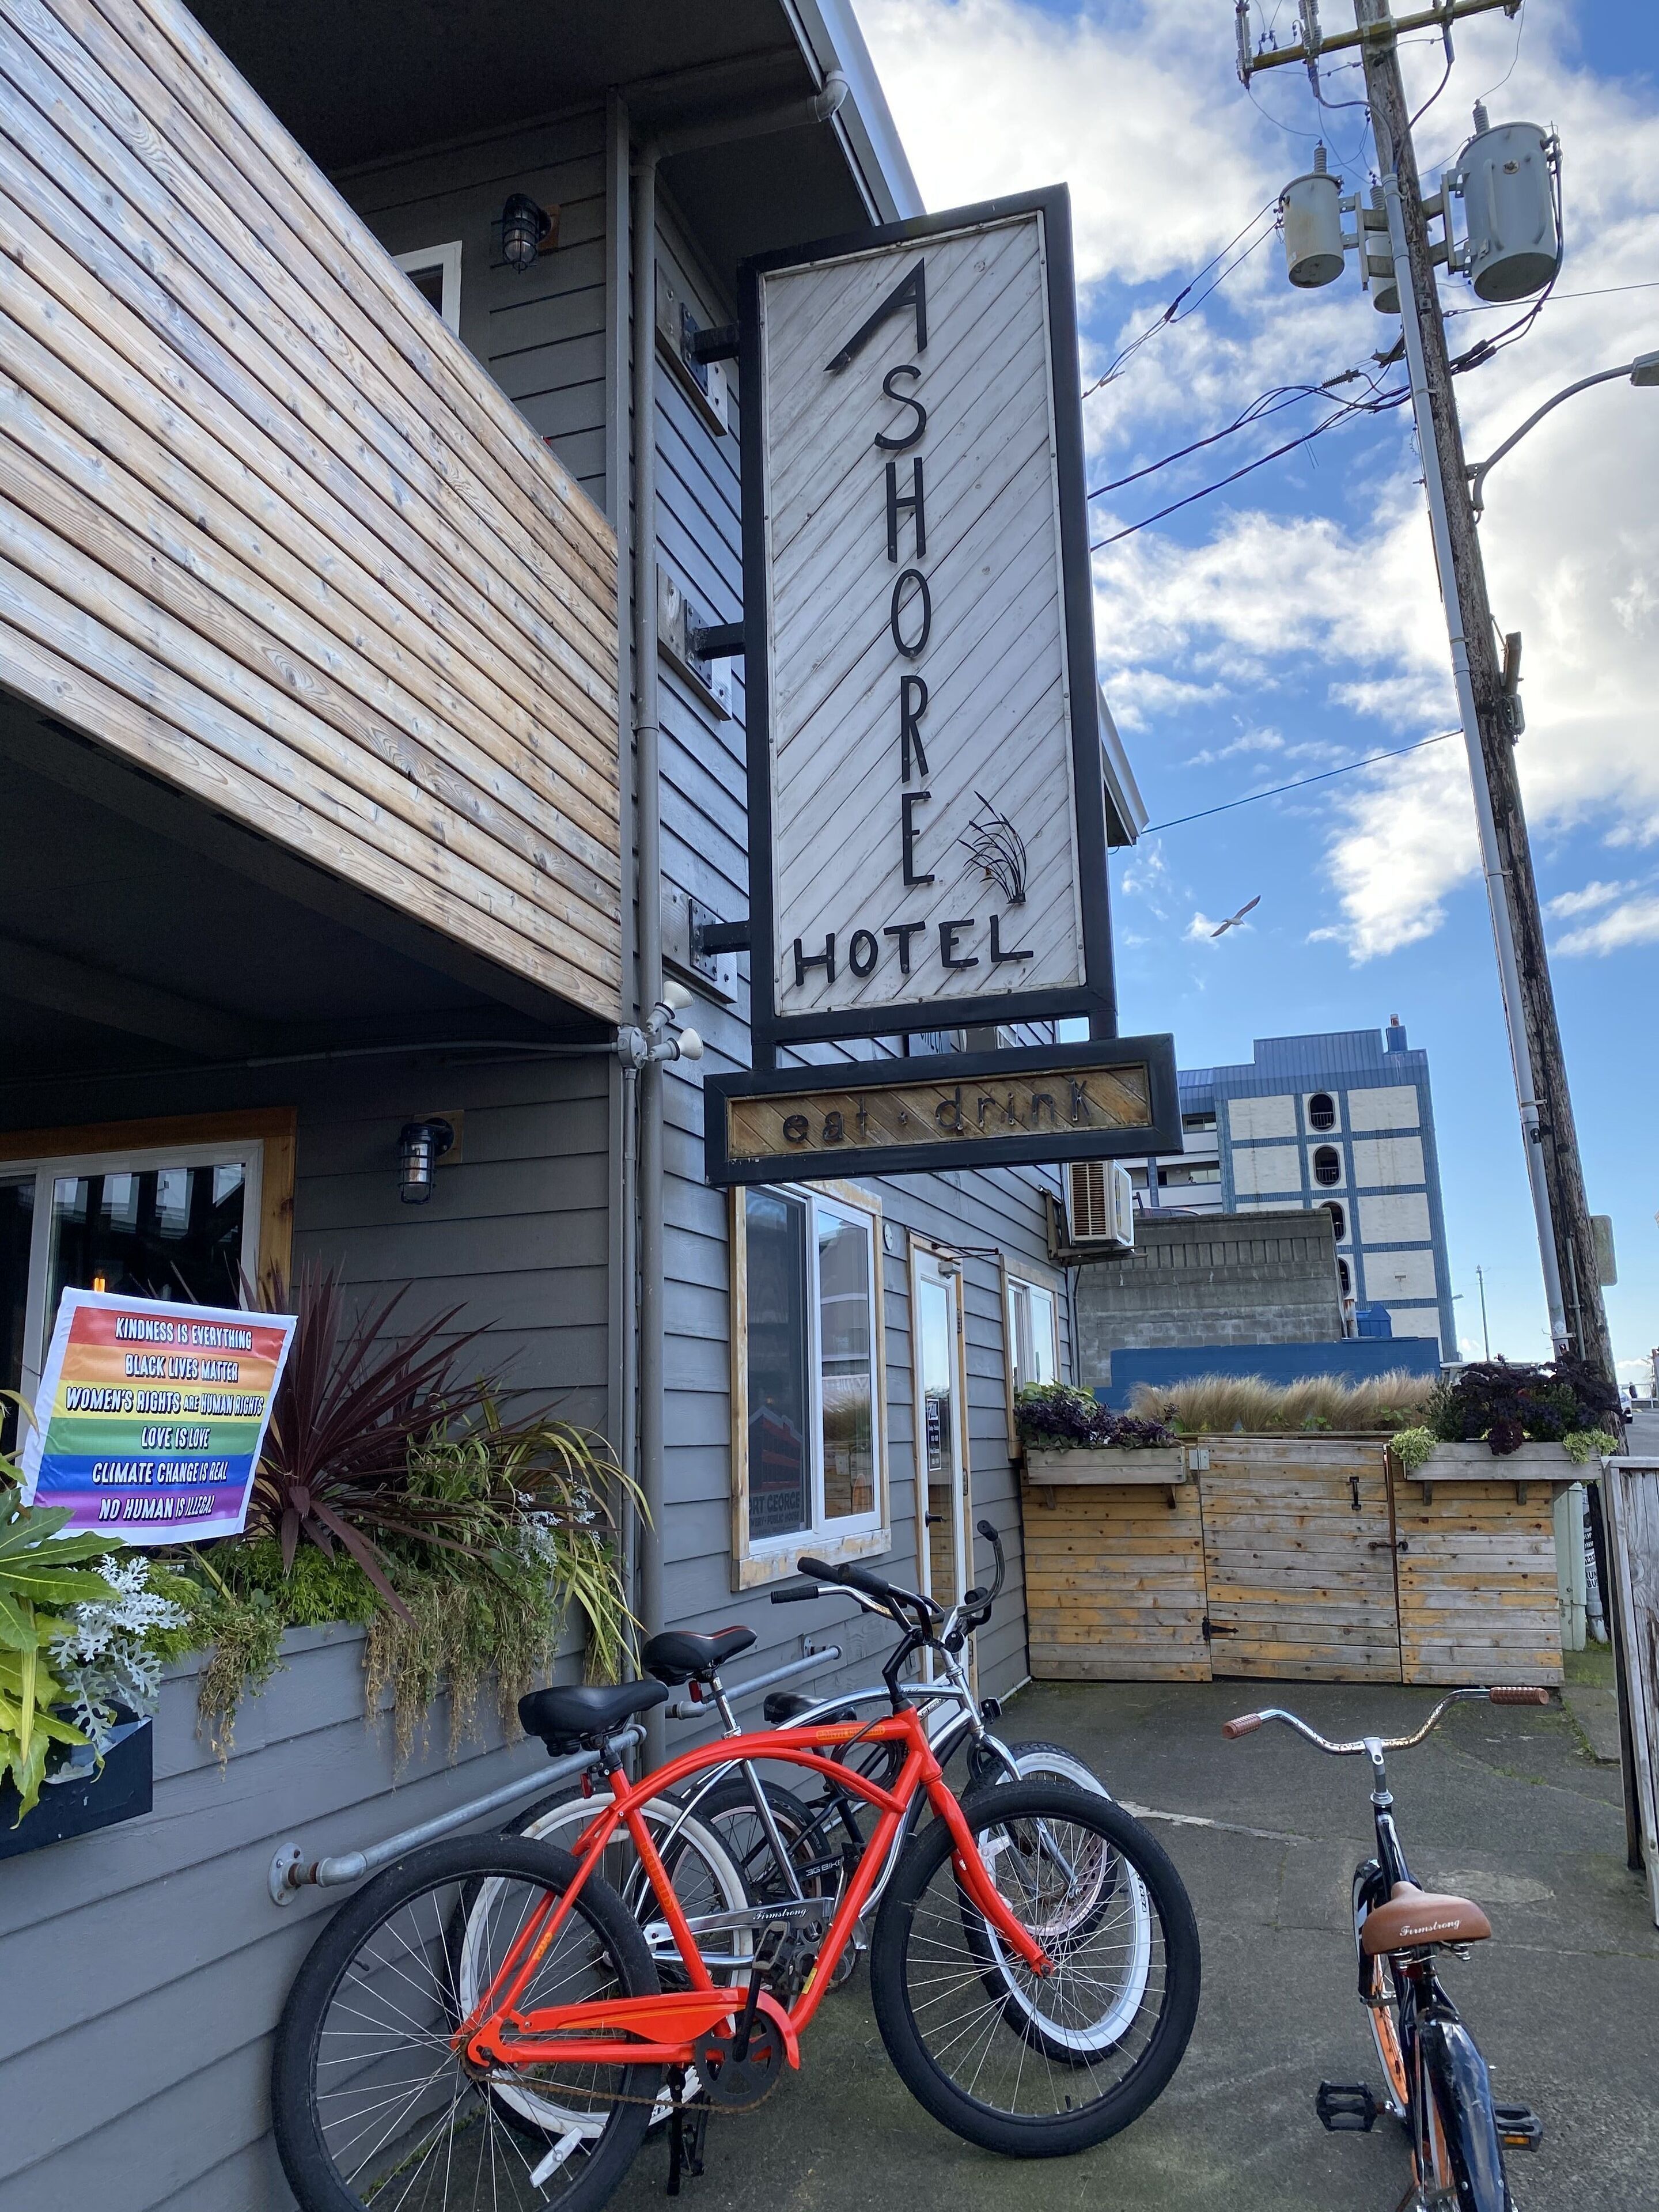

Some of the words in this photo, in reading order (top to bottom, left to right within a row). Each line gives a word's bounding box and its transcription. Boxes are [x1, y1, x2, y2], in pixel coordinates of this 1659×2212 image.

[824, 257, 934, 886] ASHORE
[793, 914, 1034, 987] HOTEL
[782, 1097, 870, 1144] eat
[935, 1079, 1093, 1132] drink
[115, 1317, 174, 1343] KINDNESS
[177, 1323, 188, 1344] IS
[191, 1325, 252, 1351] EVERYTHING
[125, 1354, 165, 1378] BLACK
[168, 1357, 198, 1380] LIVES
[201, 1359, 238, 1382] MATTER
[66, 1387, 134, 1412] WOMEN'S
[137, 1390, 181, 1414] RIGHTS
[183, 1395, 199, 1411] ARE
[200, 1392, 234, 1416] HUMAN
[234, 1395, 264, 1416] RIGHTS
[141, 1426, 173, 1449] LOVE
[175, 1427, 188, 1449] IS
[188, 1427, 211, 1449] LOVE
[92, 1461, 154, 1485] CLIMATE
[157, 1462, 199, 1484] CHANGE
[199, 1461, 209, 1482] IS
[209, 1461, 228, 1481] REAL
[99, 1498, 122, 1521] NO
[122, 1497, 174, 1520] HUMAN
[175, 1497, 185, 1519] IS
[184, 1495, 215, 1517] ILLEGAL
[767, 1491, 800, 1513] GEORGE
[753, 1908, 809, 1921] Firmstrong
[1399, 1919, 1461, 1937] Firmstrong
